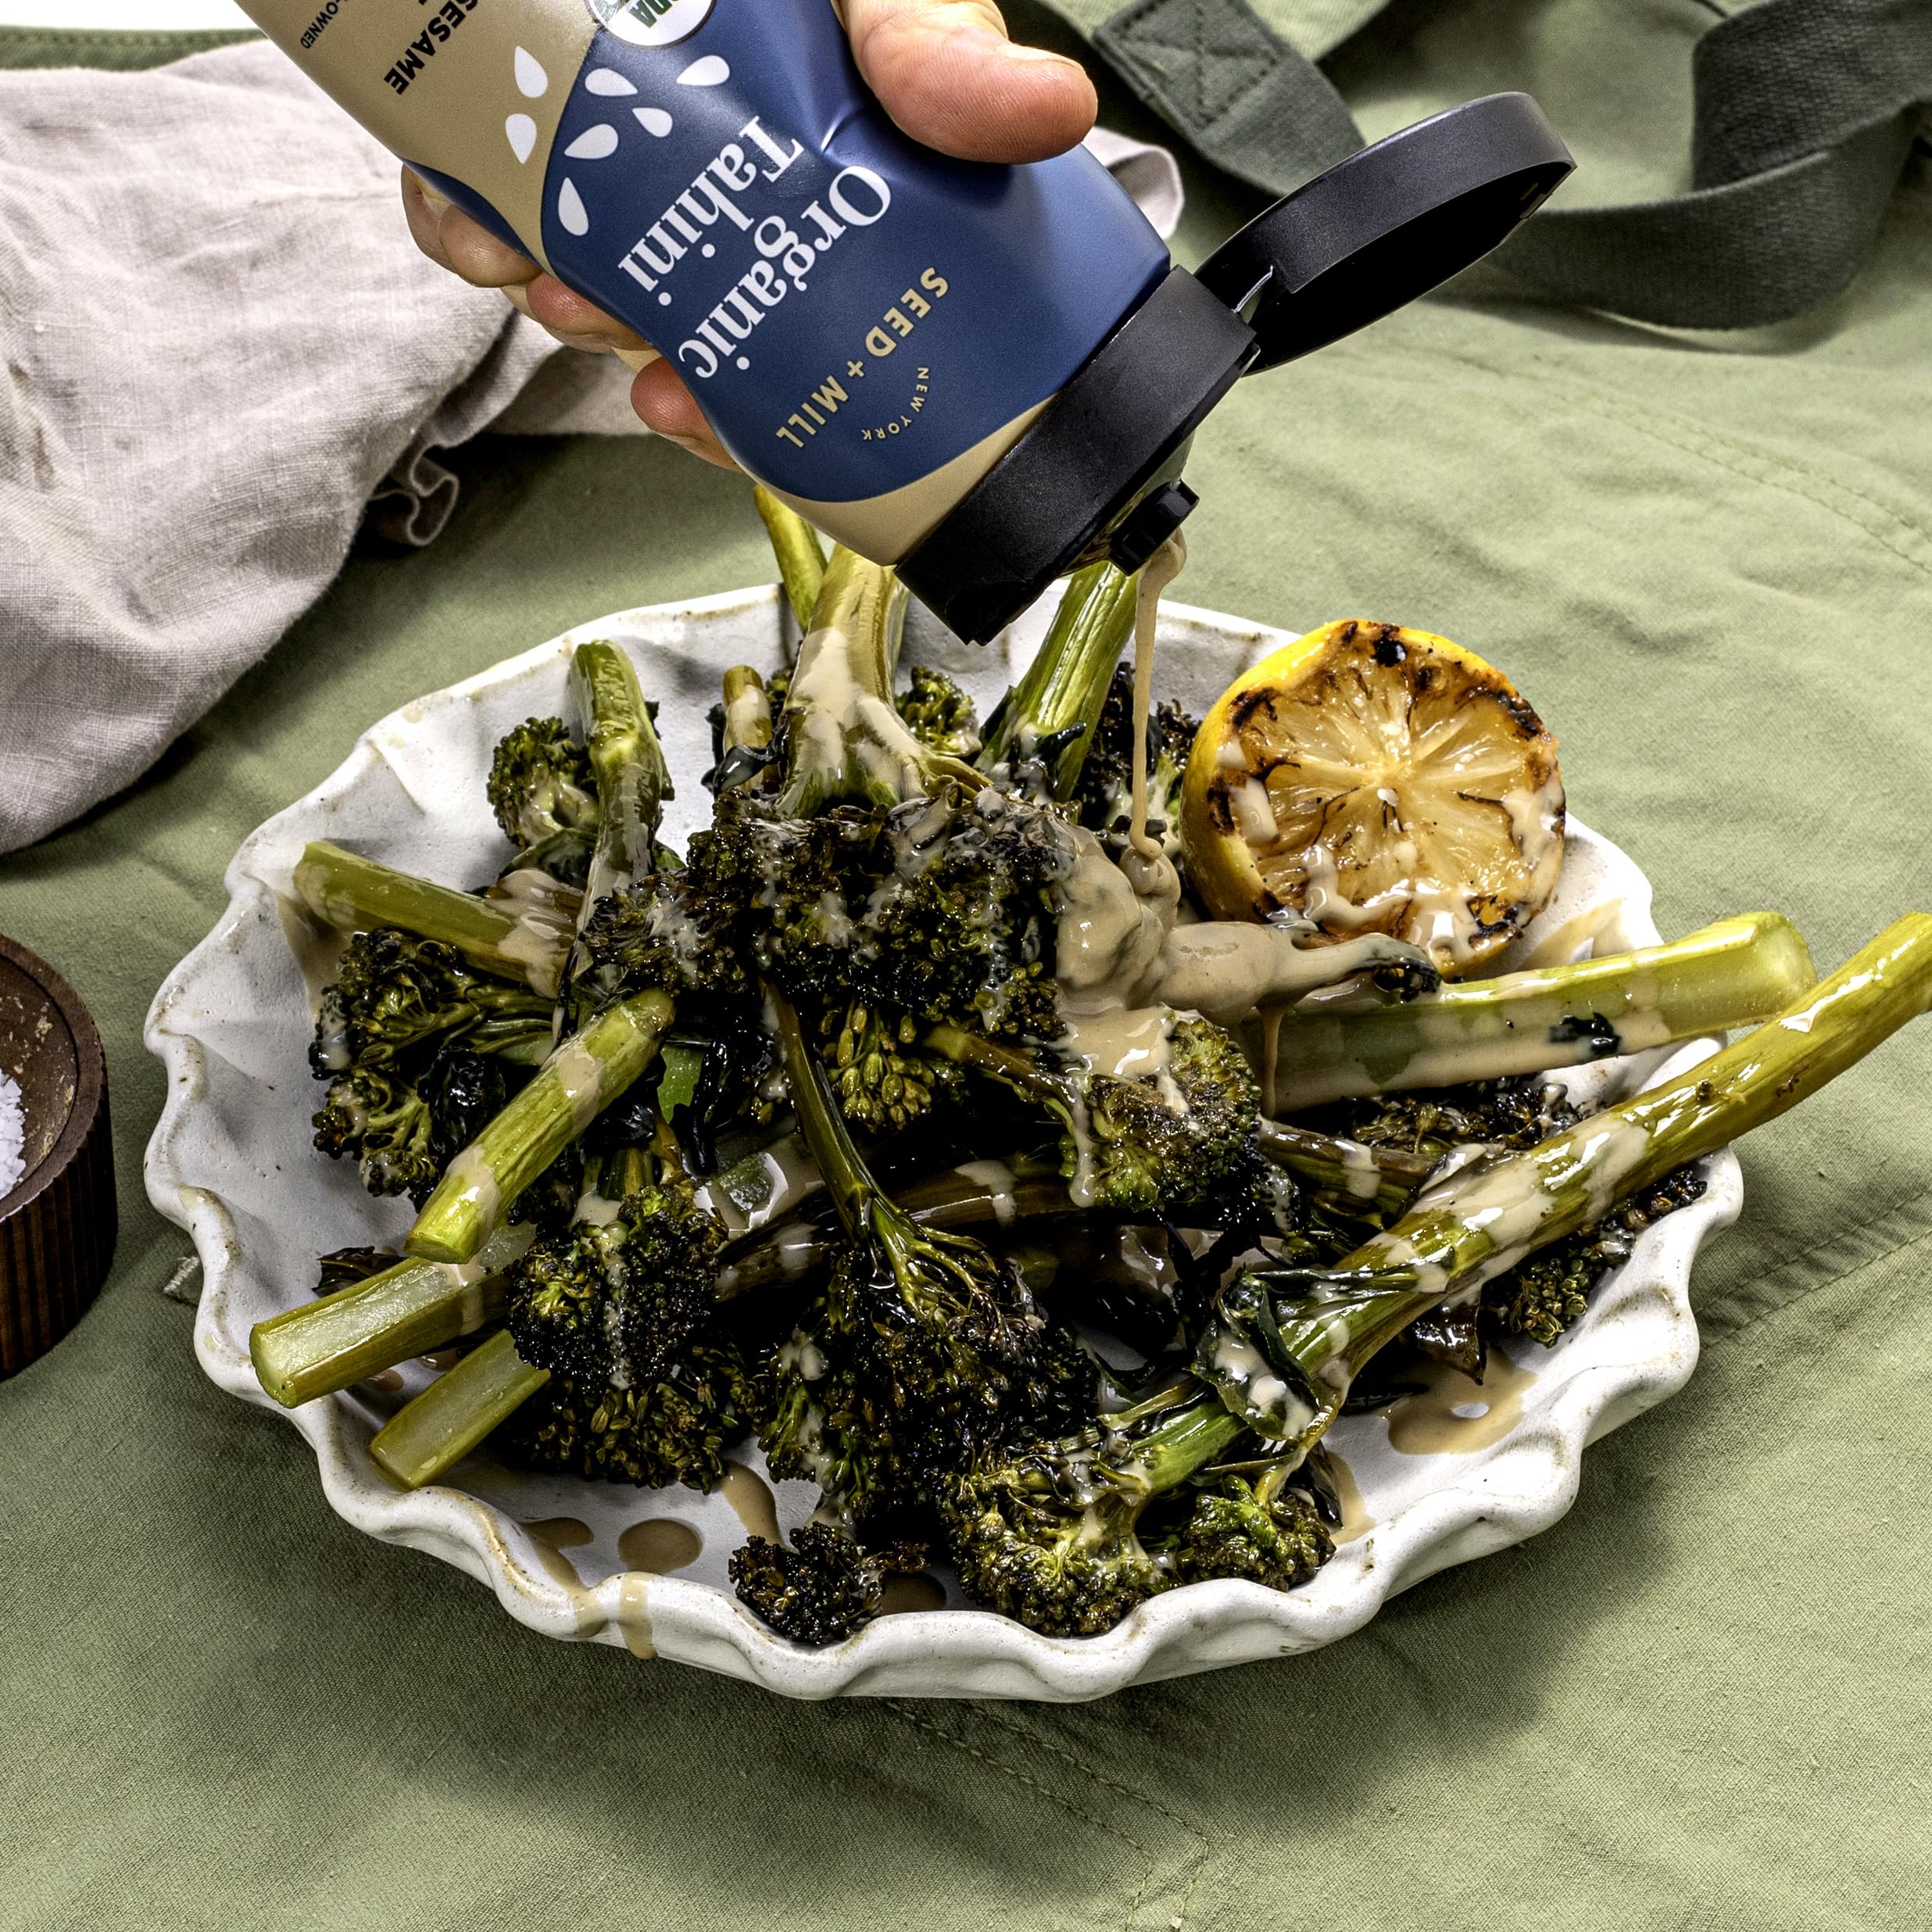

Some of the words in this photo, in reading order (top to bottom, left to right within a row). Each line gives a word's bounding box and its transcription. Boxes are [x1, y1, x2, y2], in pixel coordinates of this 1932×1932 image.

[300, 0, 346, 49] -OWNED
[618, 115, 805, 306] Tahini
[678, 165, 892, 378] Organic
[865, 267, 950, 358] SEED
[846, 360, 865, 378] +
[911, 367, 929, 413] NEW
[775, 374, 850, 449] MILL
[861, 415, 912, 440] YORK
